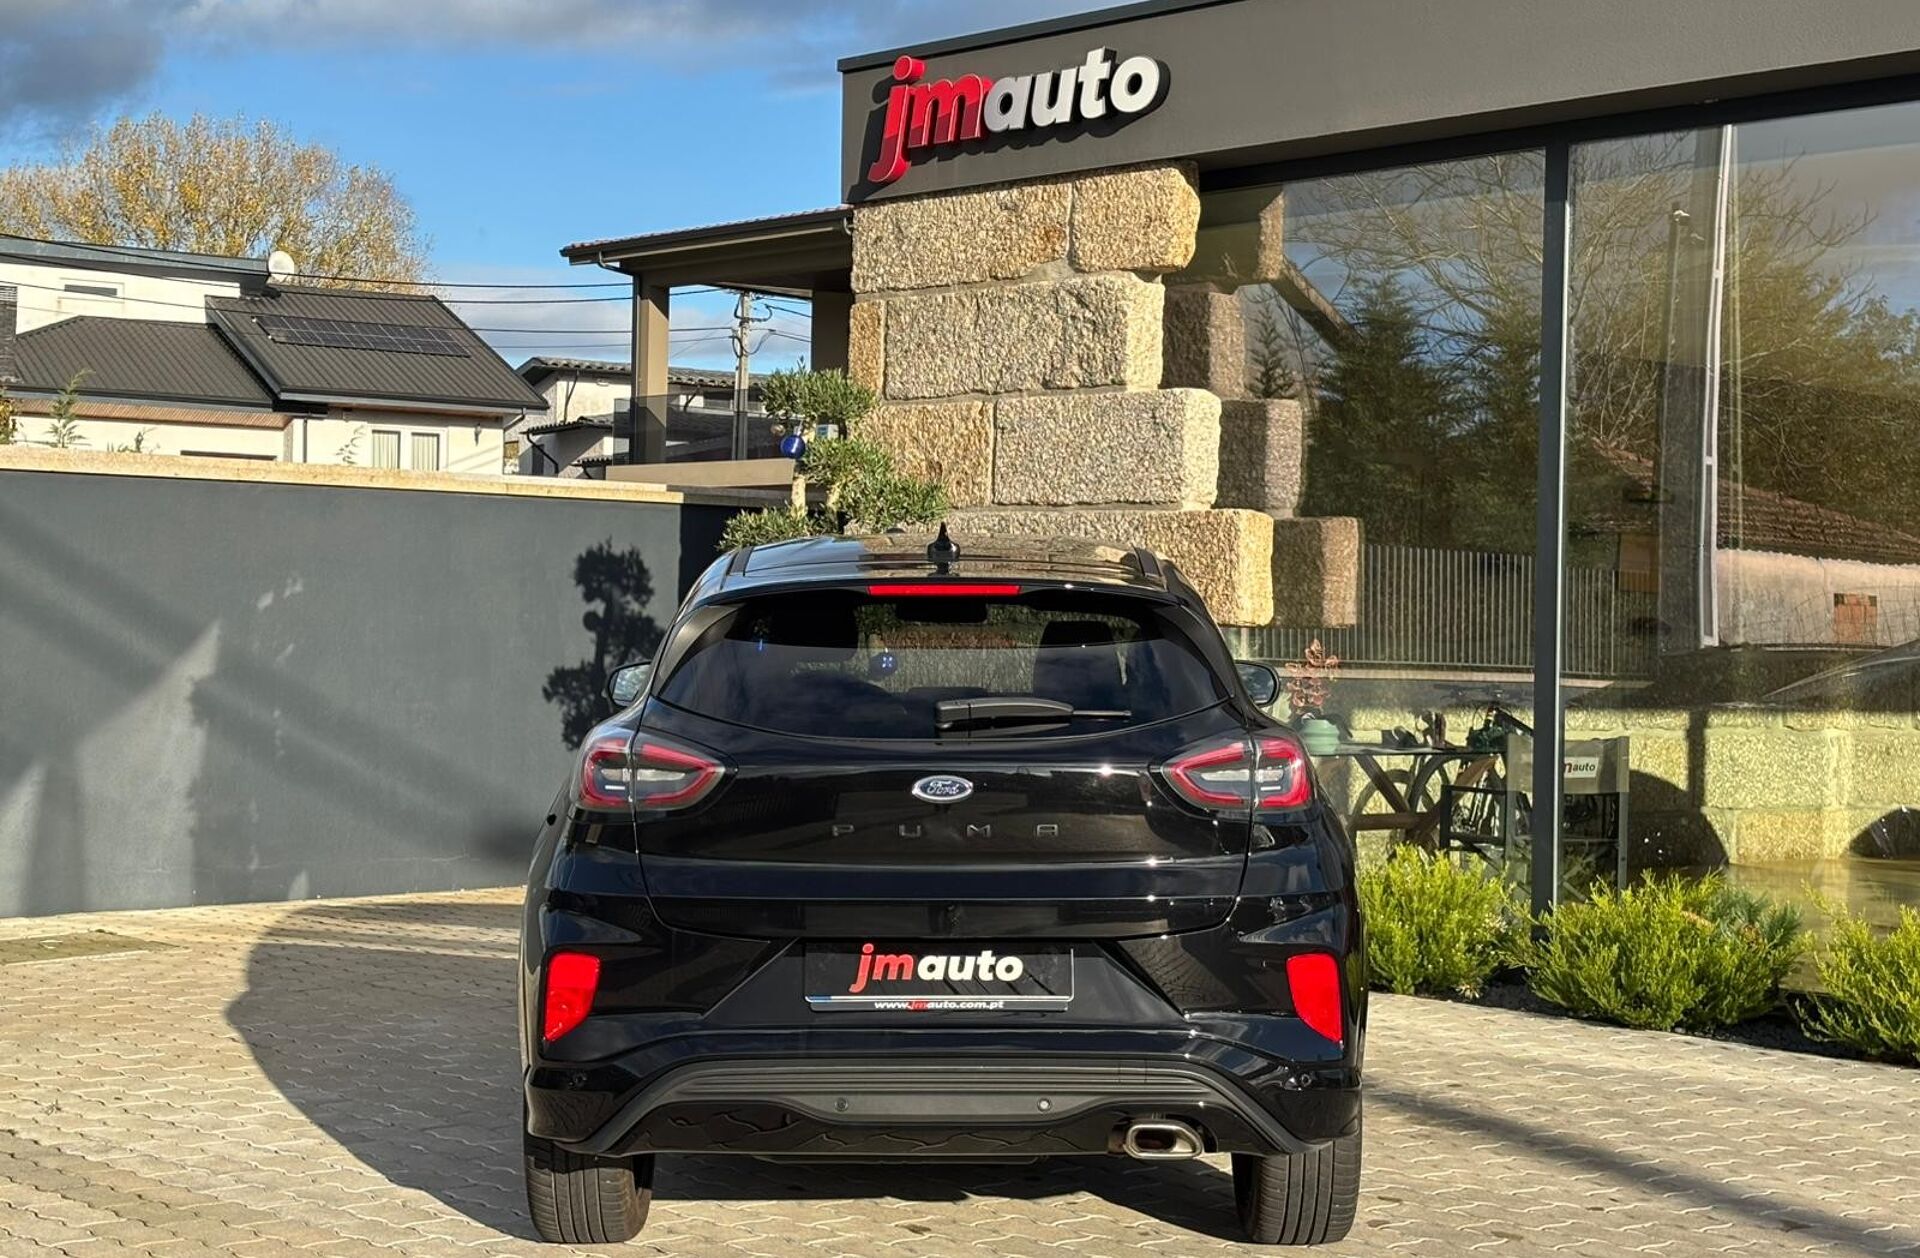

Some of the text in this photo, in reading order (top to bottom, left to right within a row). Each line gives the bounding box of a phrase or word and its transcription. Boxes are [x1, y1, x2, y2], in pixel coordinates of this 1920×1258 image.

[926, 780, 961, 795] Ford
[832, 824, 1059, 837] PUMA
[874, 1000, 1004, 1010] www.jmauto.com.pt
